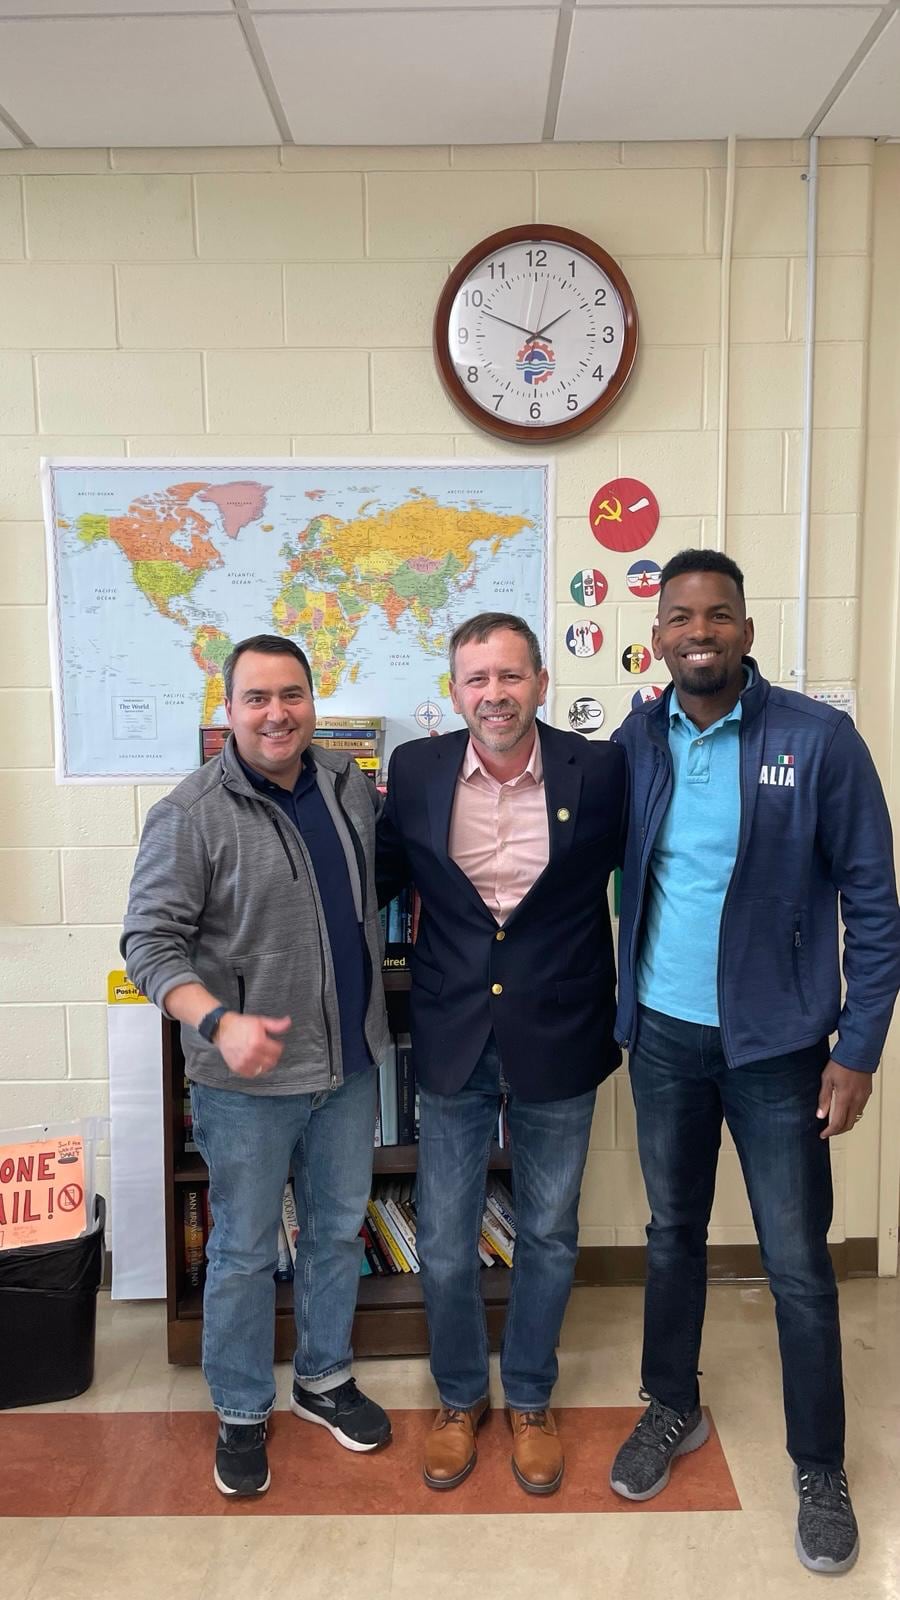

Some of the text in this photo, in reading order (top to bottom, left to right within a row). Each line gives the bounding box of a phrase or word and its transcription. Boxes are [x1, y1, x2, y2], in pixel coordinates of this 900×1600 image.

[525, 250, 547, 267] 12
[487, 262, 506, 280] 11
[568, 260, 576, 277] 1
[462, 289, 483, 307] 10
[594, 288, 607, 306] 2
[457, 327, 469, 345] 9
[602, 326, 615, 344] 3
[467, 366, 479, 383] 8
[592, 364, 604, 382] 4
[492, 394, 504, 411] 7
[529, 402, 541, 419] 6
[566, 394, 579, 411] 5
[759, 765, 795, 787] ALIA
[188, 1192, 198, 1211] DAN
